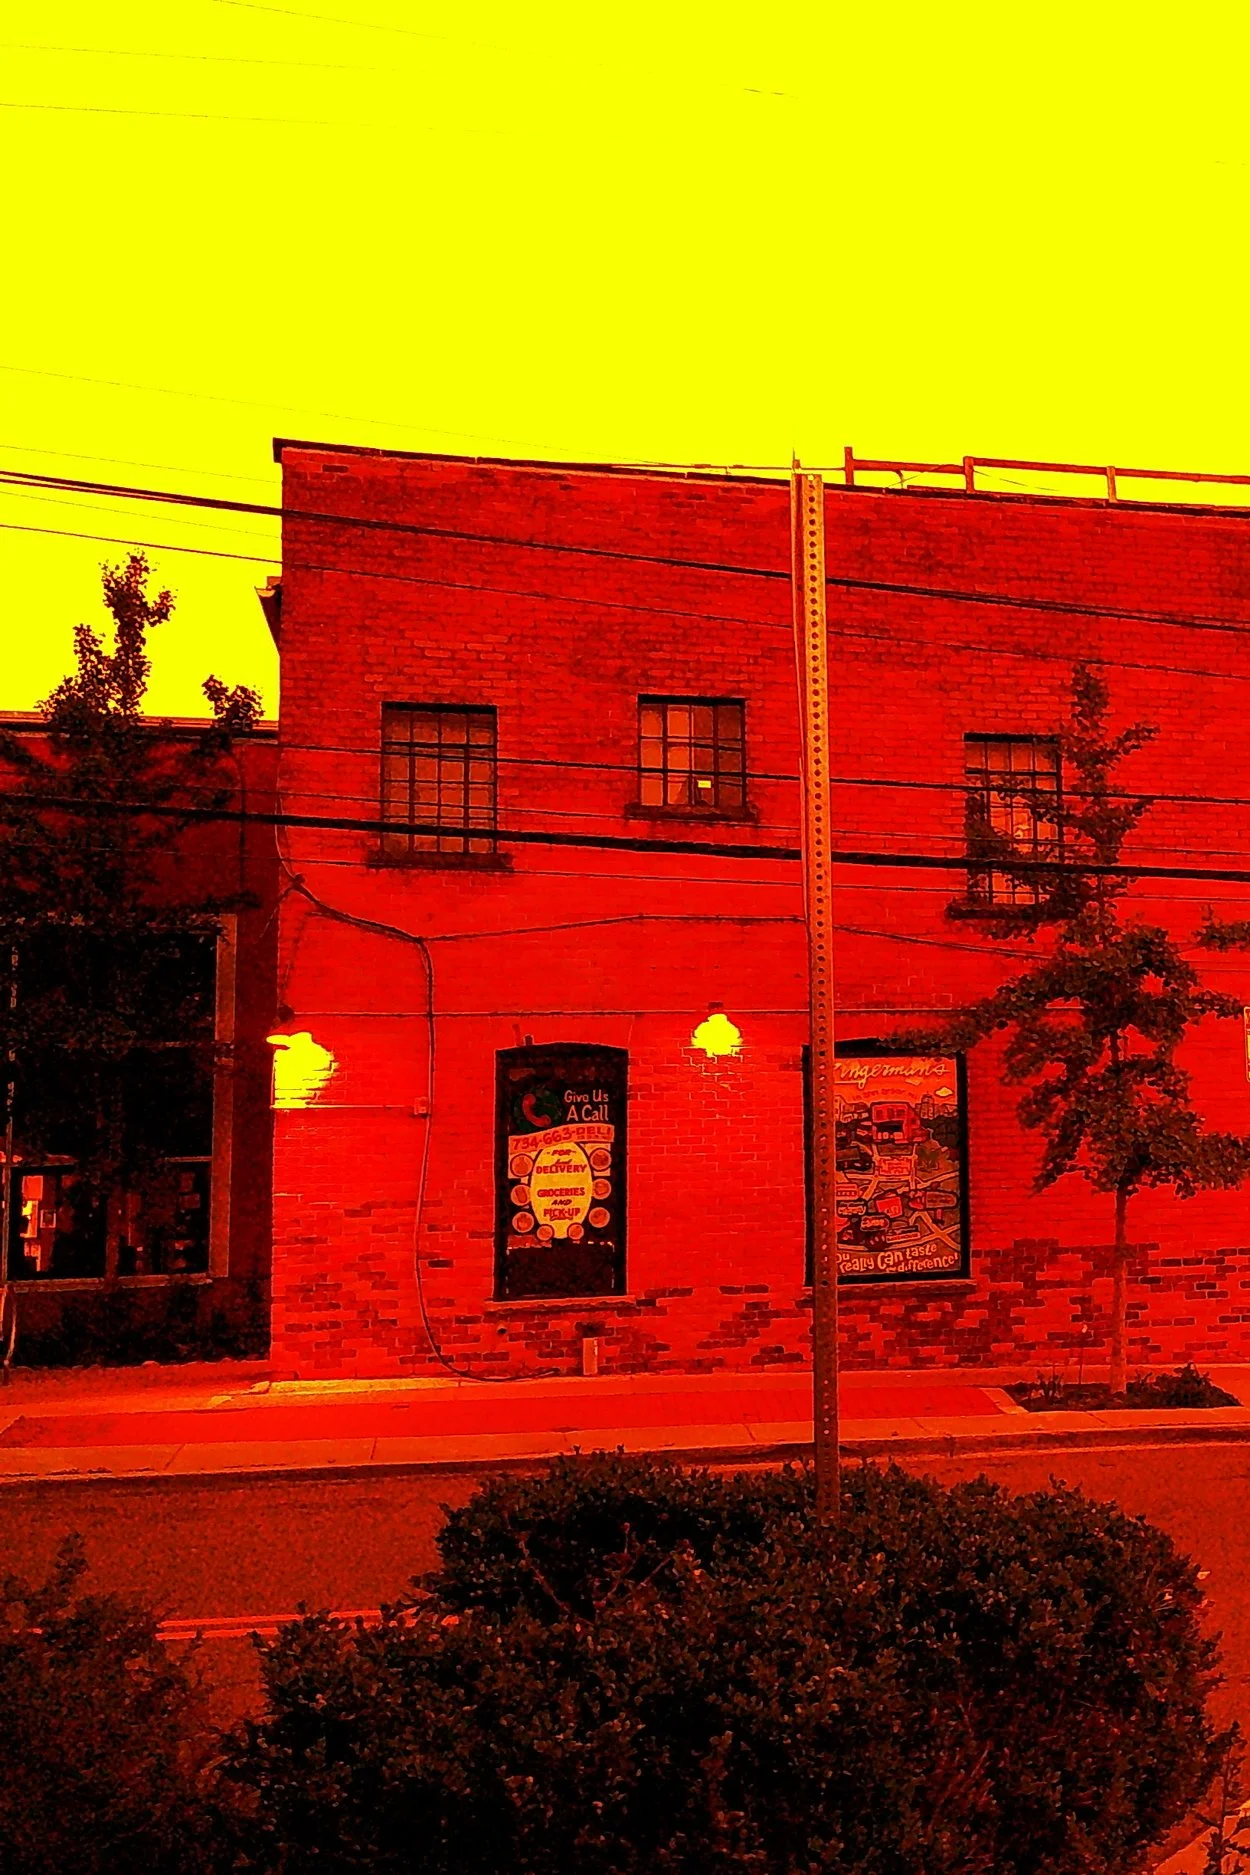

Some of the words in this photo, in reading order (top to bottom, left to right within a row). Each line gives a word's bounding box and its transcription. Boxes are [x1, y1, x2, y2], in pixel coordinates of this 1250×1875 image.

[564, 1090, 589, 1103] Give
[592, 1089, 609, 1102] Us
[566, 1104, 579, 1121] A
[582, 1104, 609, 1121] Call
[512, 1126, 612, 1150] 734-663-DELI
[536, 1164, 587, 1174] DELIVERY
[537, 1187, 585, 1198] GROCERIES
[543, 1207, 581, 1217] PICK-UP
[839, 1257, 875, 1273] really
[905, 1244, 937, 1259] taste
[897, 1252, 959, 1272] difference!
